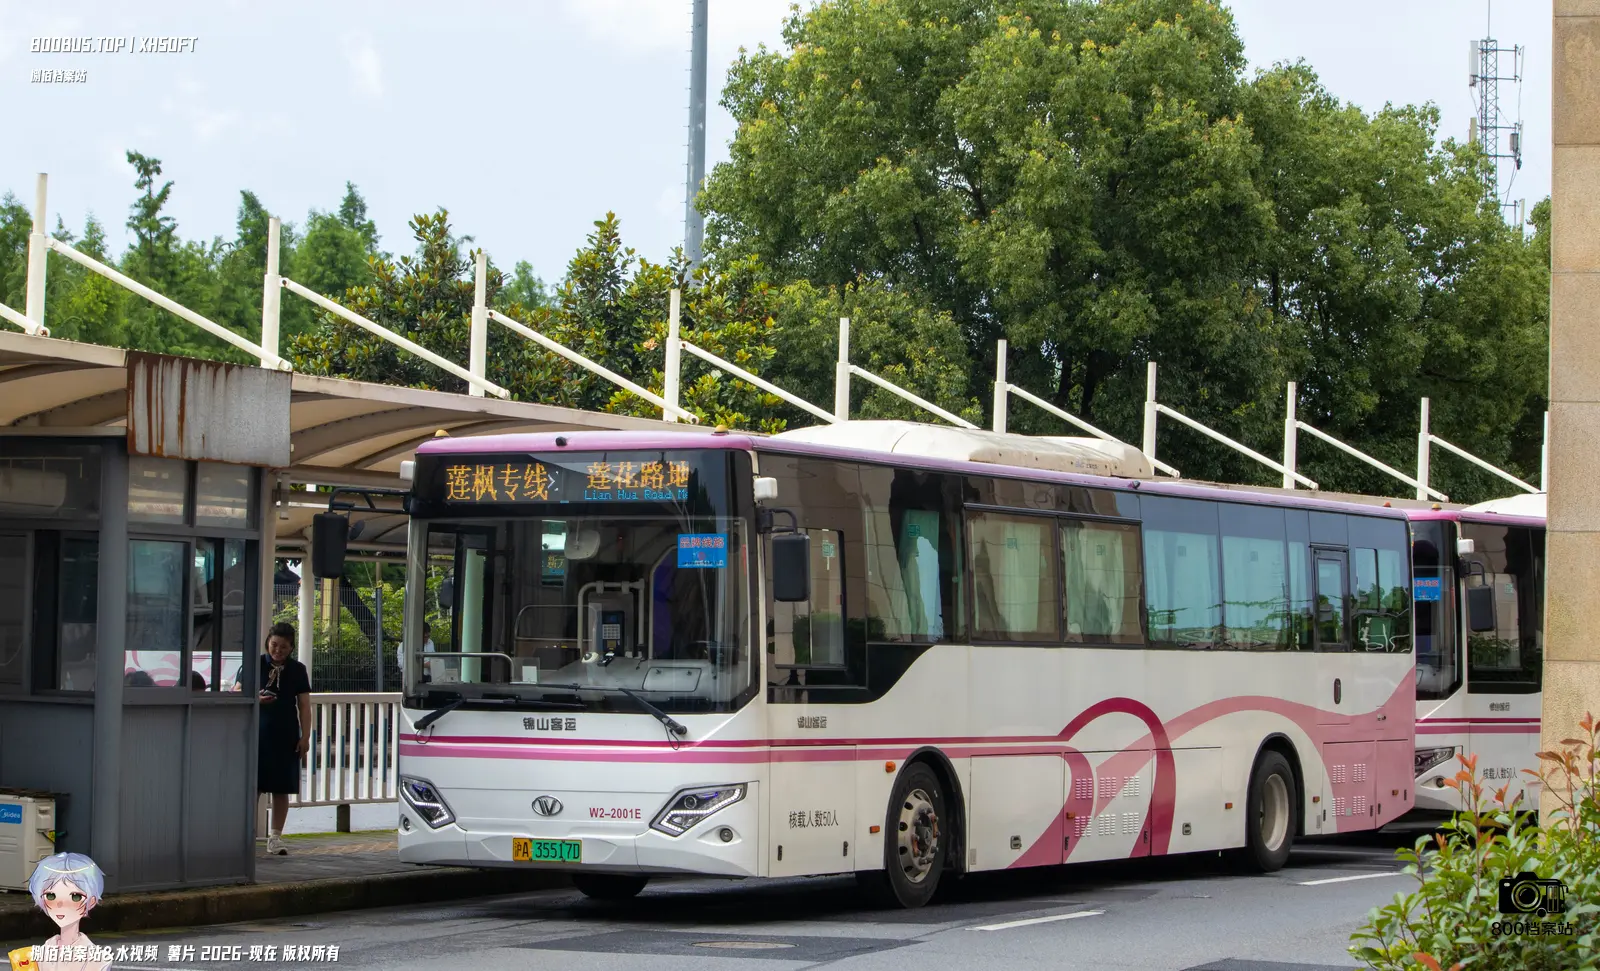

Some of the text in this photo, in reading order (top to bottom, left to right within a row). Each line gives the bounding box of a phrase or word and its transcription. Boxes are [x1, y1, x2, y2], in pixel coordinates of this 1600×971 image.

[446, 462, 549, 501] 莲枫专线
[584, 489, 613, 501] Lian
[617, 489, 639, 501] Hua
[644, 489, 673, 501] Road
[589, 806, 642, 821] W2-2001E
[789, 810, 839, 829] 核载人数50人
